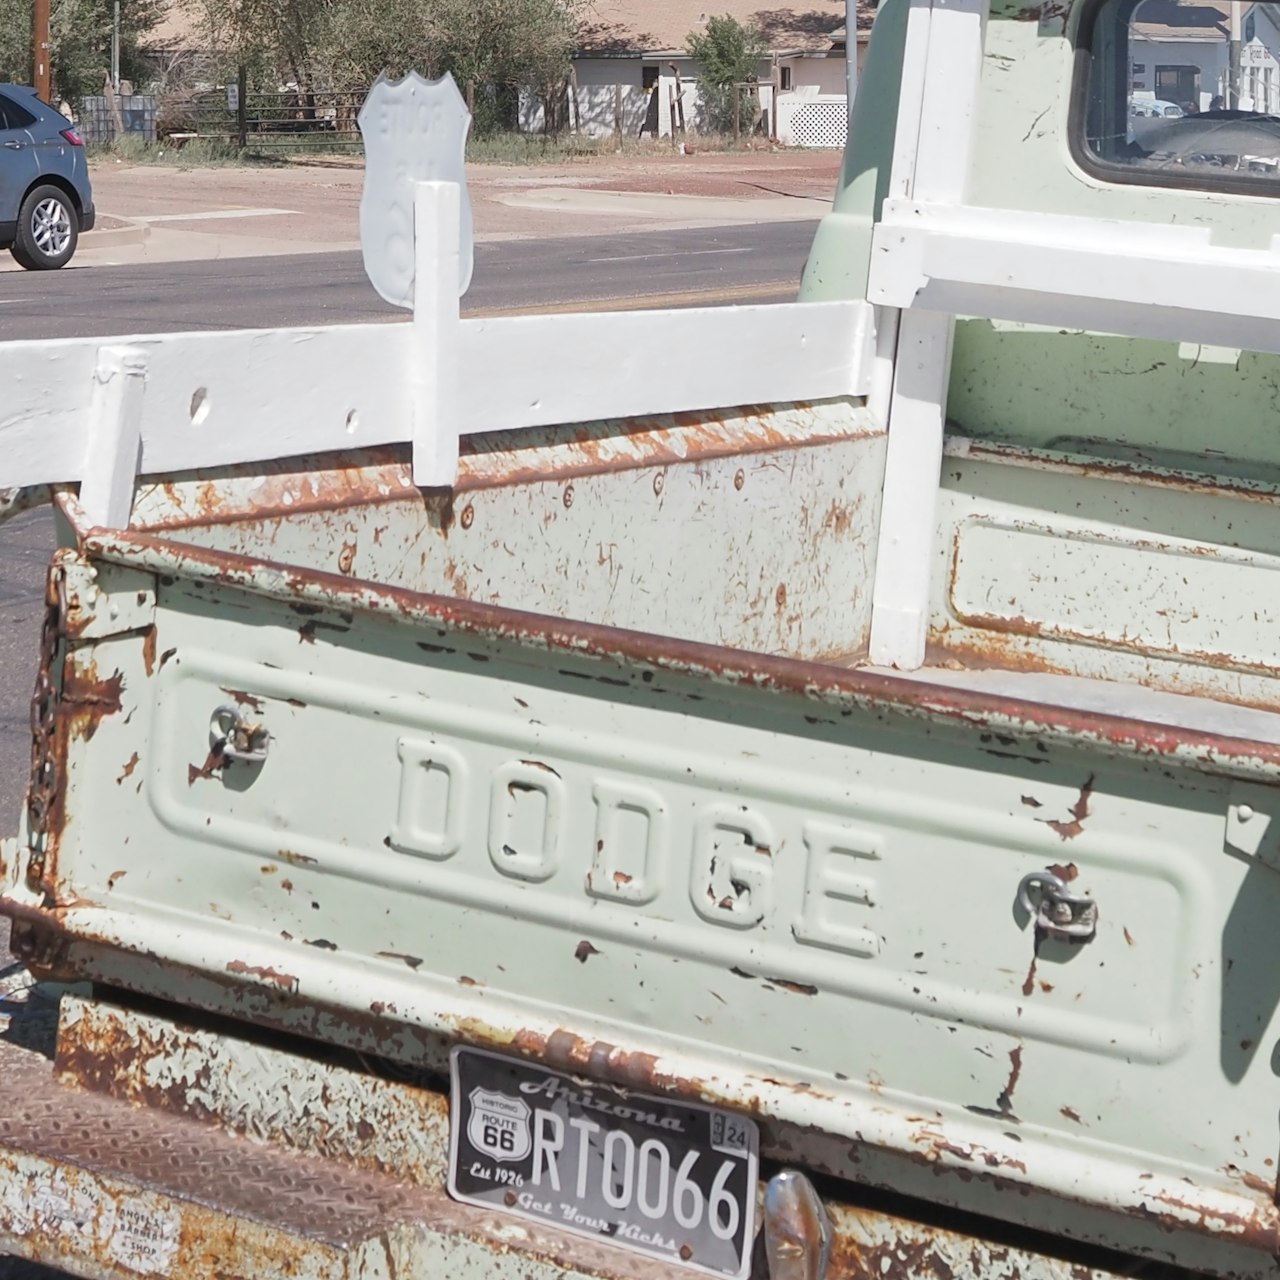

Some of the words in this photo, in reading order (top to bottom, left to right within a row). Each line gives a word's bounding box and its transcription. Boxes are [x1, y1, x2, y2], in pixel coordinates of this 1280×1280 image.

[384, 736, 886, 959] DODGE
[482, 1097, 519, 1113] HISTORIC
[519, 1077, 685, 1132] Arizona
[482, 1113, 518, 1131] ROUTE
[483, 1125, 515, 1152] 66
[470, 1161, 492, 1181] Est
[494, 1167, 525, 1188] 1926
[517, 1192, 553, 1215] Get
[559, 1202, 611, 1232] Your
[615, 1220, 678, 1251] Kicks
[130, 1242, 157, 1255] SHOP
